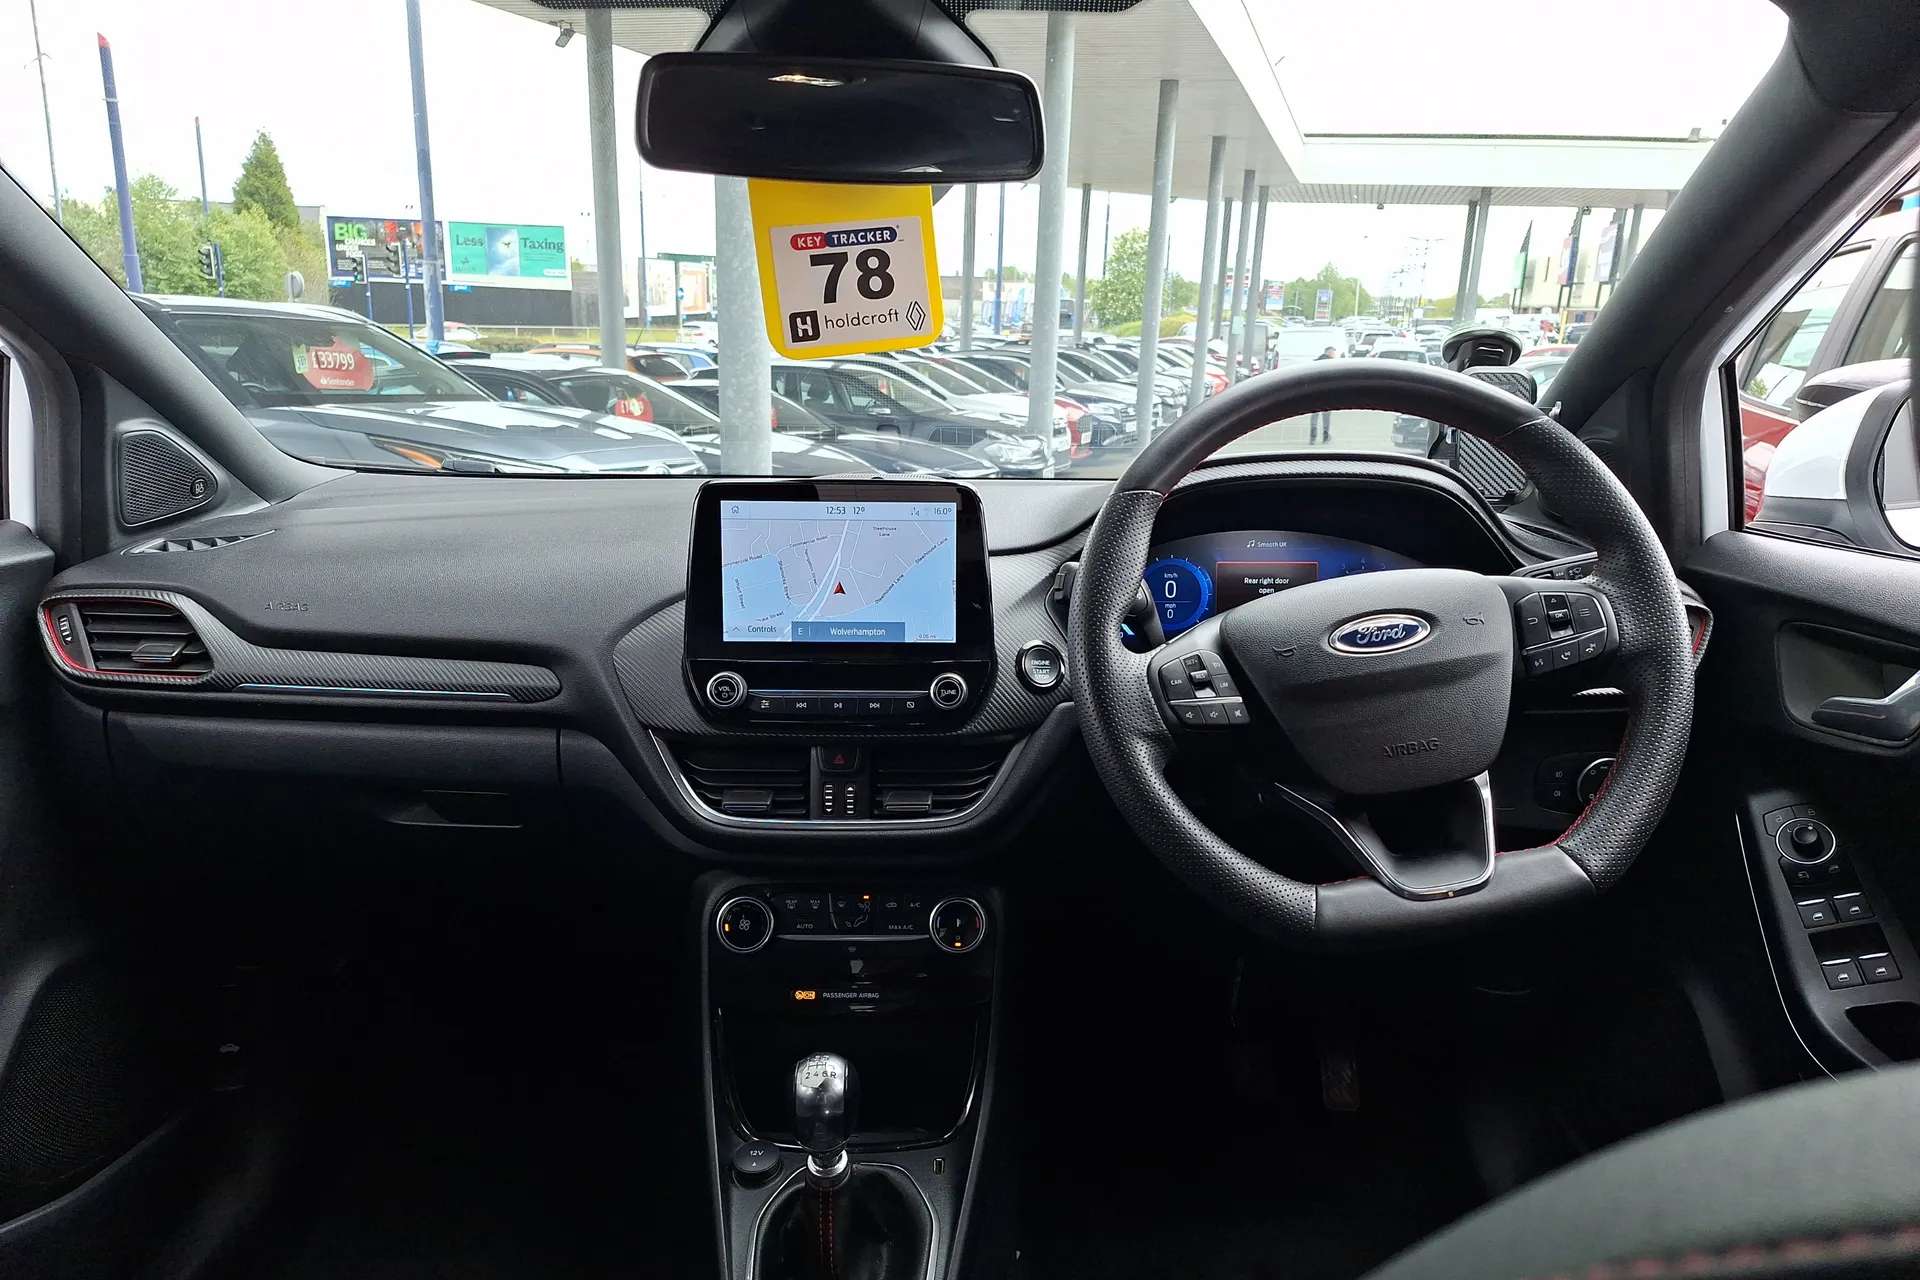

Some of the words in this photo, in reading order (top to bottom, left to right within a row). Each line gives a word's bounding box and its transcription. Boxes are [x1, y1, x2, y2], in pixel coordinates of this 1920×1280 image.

[334, 223, 367, 240] BIG
[796, 234, 822, 248] KEY
[831, 229, 892, 245] TRACKER
[455, 234, 484, 247] Less
[520, 237, 565, 254] Taxing
[809, 248, 895, 304] 78
[824, 308, 900, 330] holdcroft
[311, 351, 355, 370] £33799
[825, 506, 847, 516] 12:53
[1165, 580, 1177, 598] 0
[1259, 577, 1274, 585] right
[1167, 609, 1174, 619] 0
[747, 625, 777, 634] Controls
[829, 628, 886, 638] Wolverhampton
[1356, 622, 1408, 646] Ford
[1383, 737, 1440, 758] AIRBAG
[805, 1072, 811, 1080] 2
[830, 1071, 837, 1079] R
